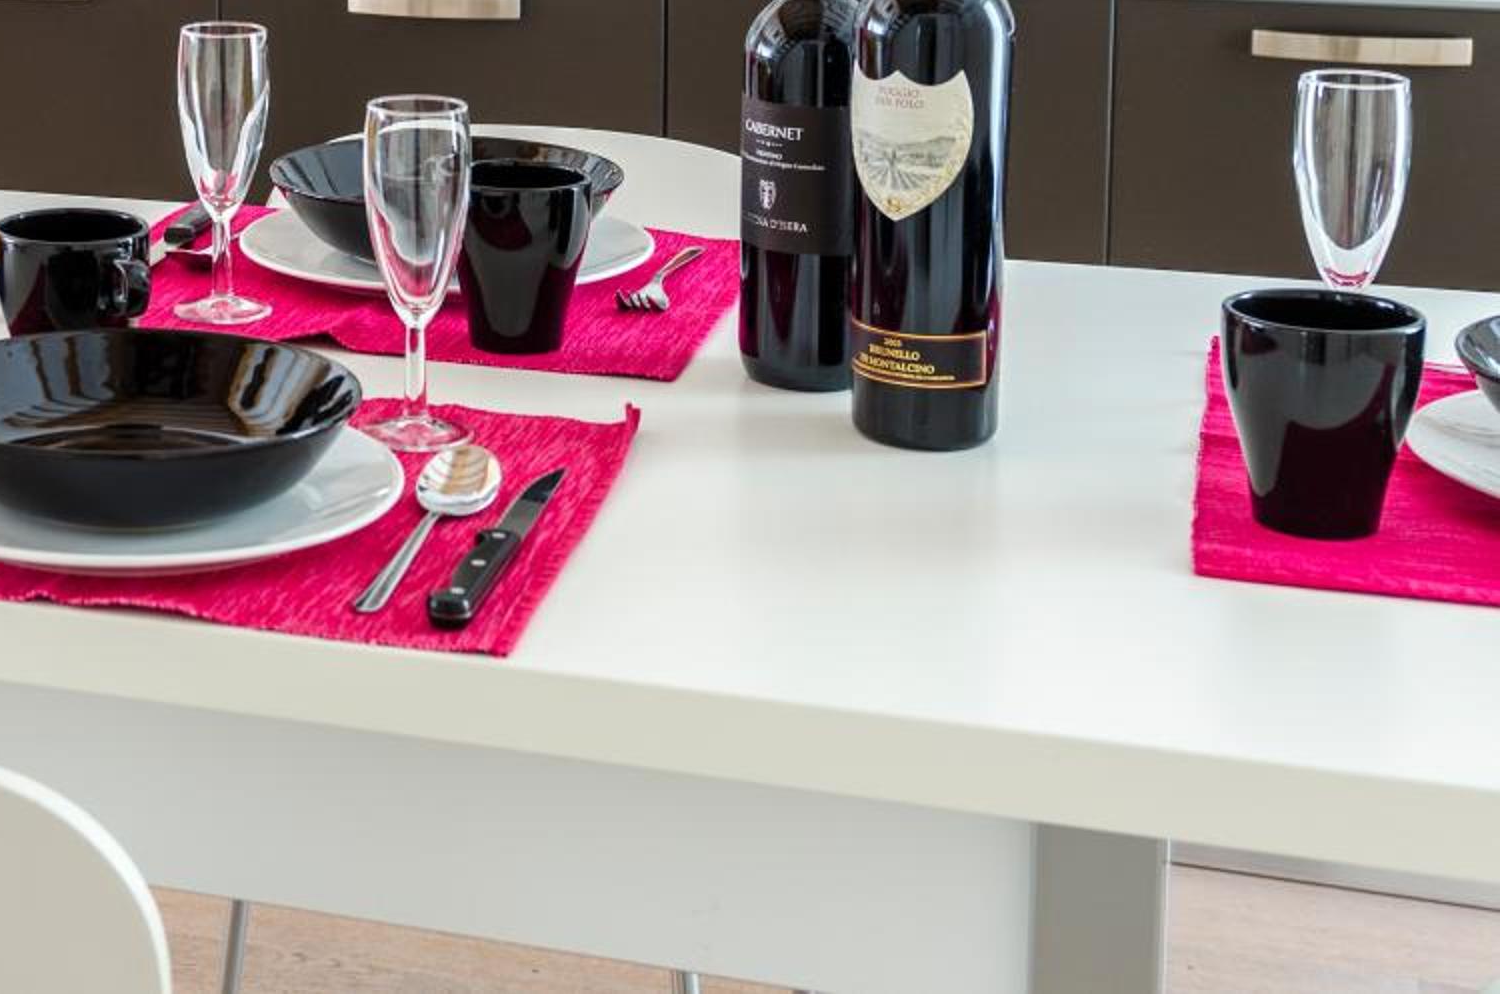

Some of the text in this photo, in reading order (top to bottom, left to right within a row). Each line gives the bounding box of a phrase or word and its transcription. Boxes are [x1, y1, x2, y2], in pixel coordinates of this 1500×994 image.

[745, 117, 804, 141] CABERNET
[869, 343, 921, 361] BRUNELLO
[868, 356, 935, 374] MONTALCINO
